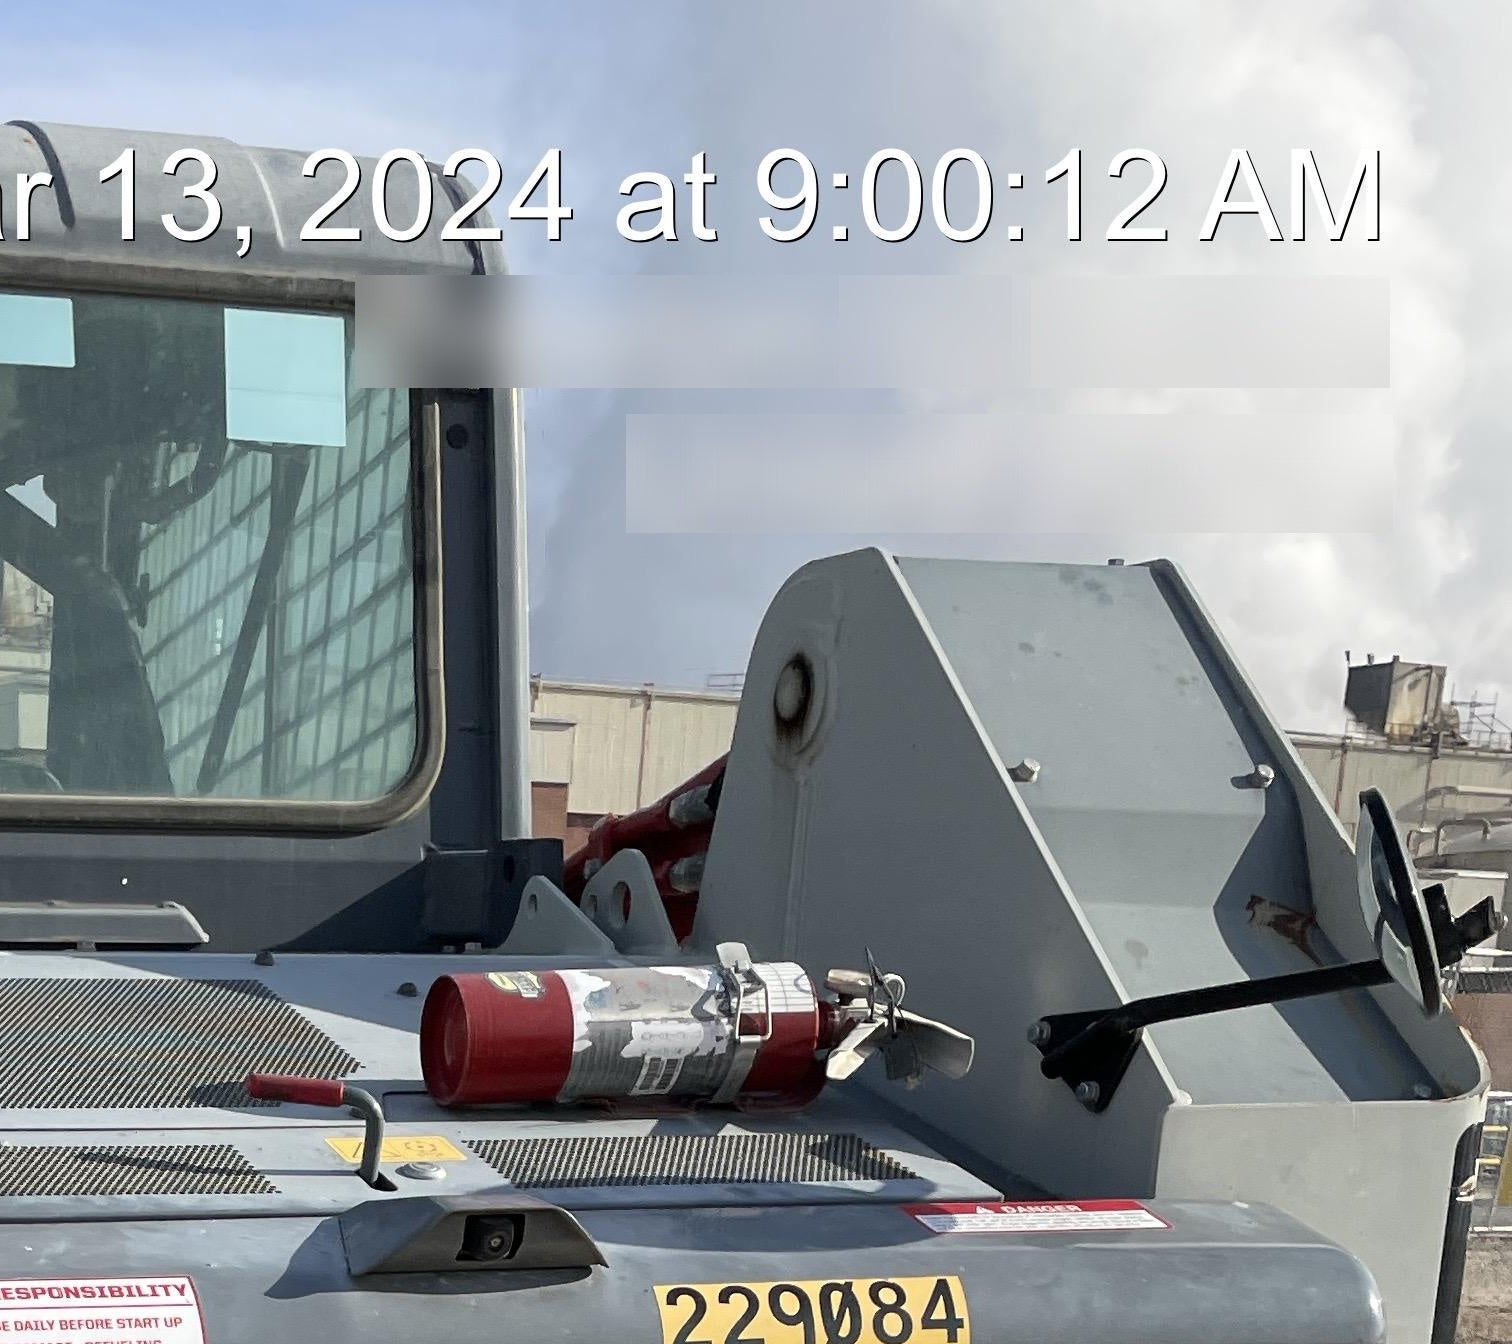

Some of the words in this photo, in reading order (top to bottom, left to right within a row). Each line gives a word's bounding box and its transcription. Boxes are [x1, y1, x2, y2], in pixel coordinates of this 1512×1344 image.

[1000, 1204, 1083, 1214] DANGER
[14, 1320, 55, 1331] DAILY
[59, 1318, 113, 1330] BEFORE
[116, 1317, 160, 1329] START
[163, 1316, 183, 1328] UP
